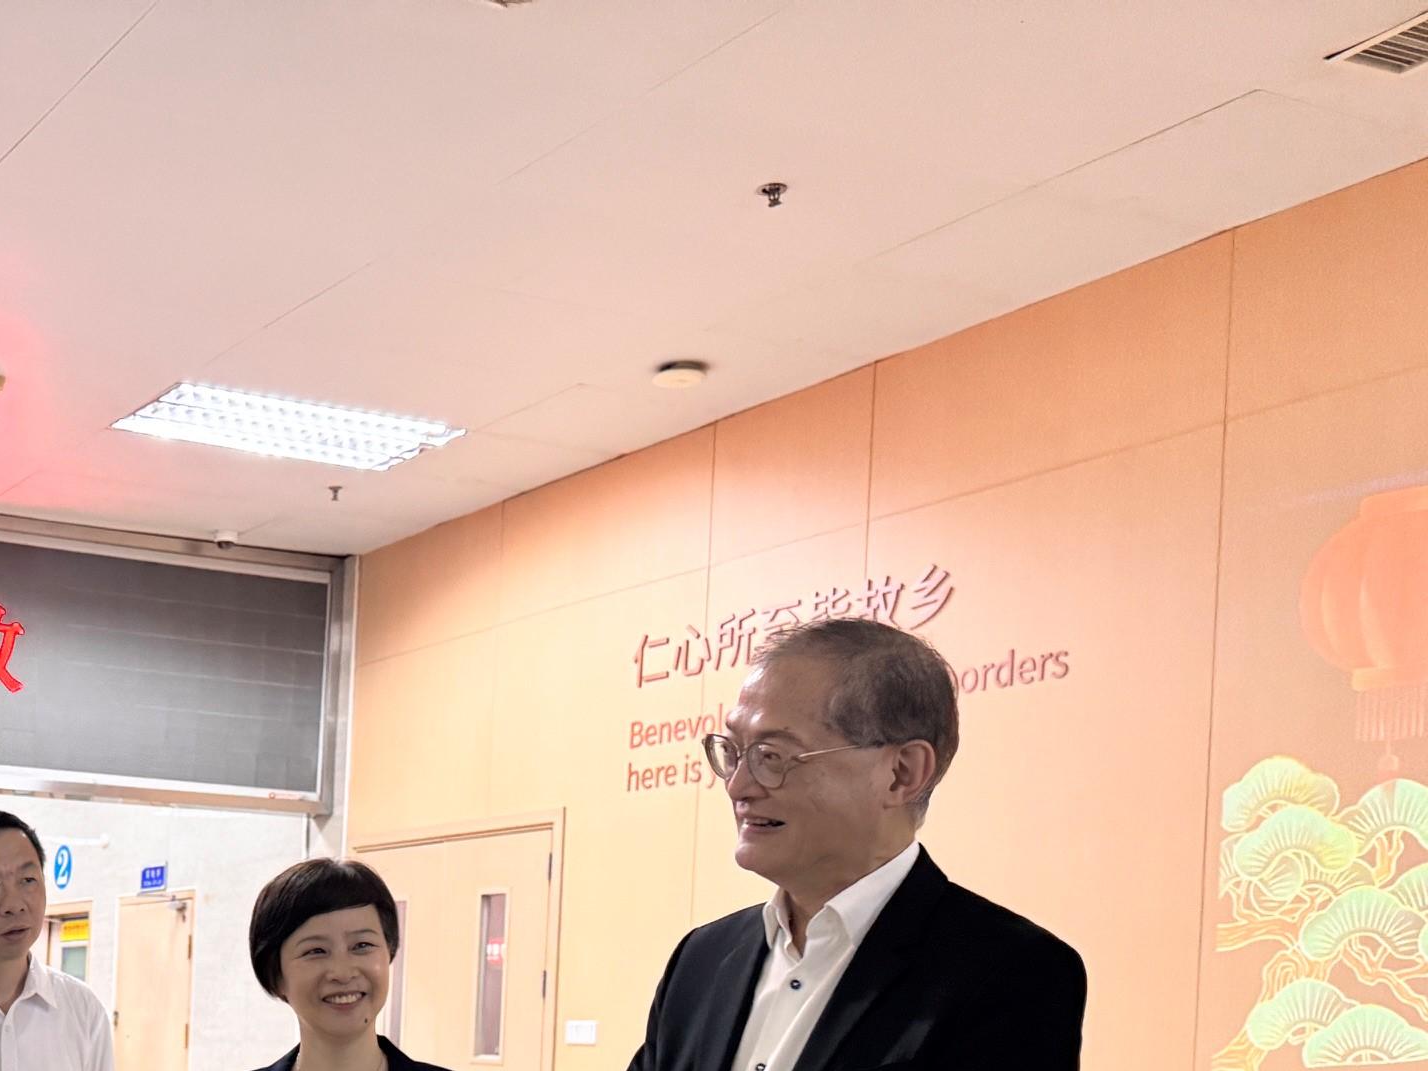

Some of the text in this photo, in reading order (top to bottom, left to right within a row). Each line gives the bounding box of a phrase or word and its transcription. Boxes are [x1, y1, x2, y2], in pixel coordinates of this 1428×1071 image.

[629, 648, 1070, 750] Benevol orders
[627, 762, 677, 793] here
[683, 755, 703, 786] is
[56, 848, 70, 886] 2
